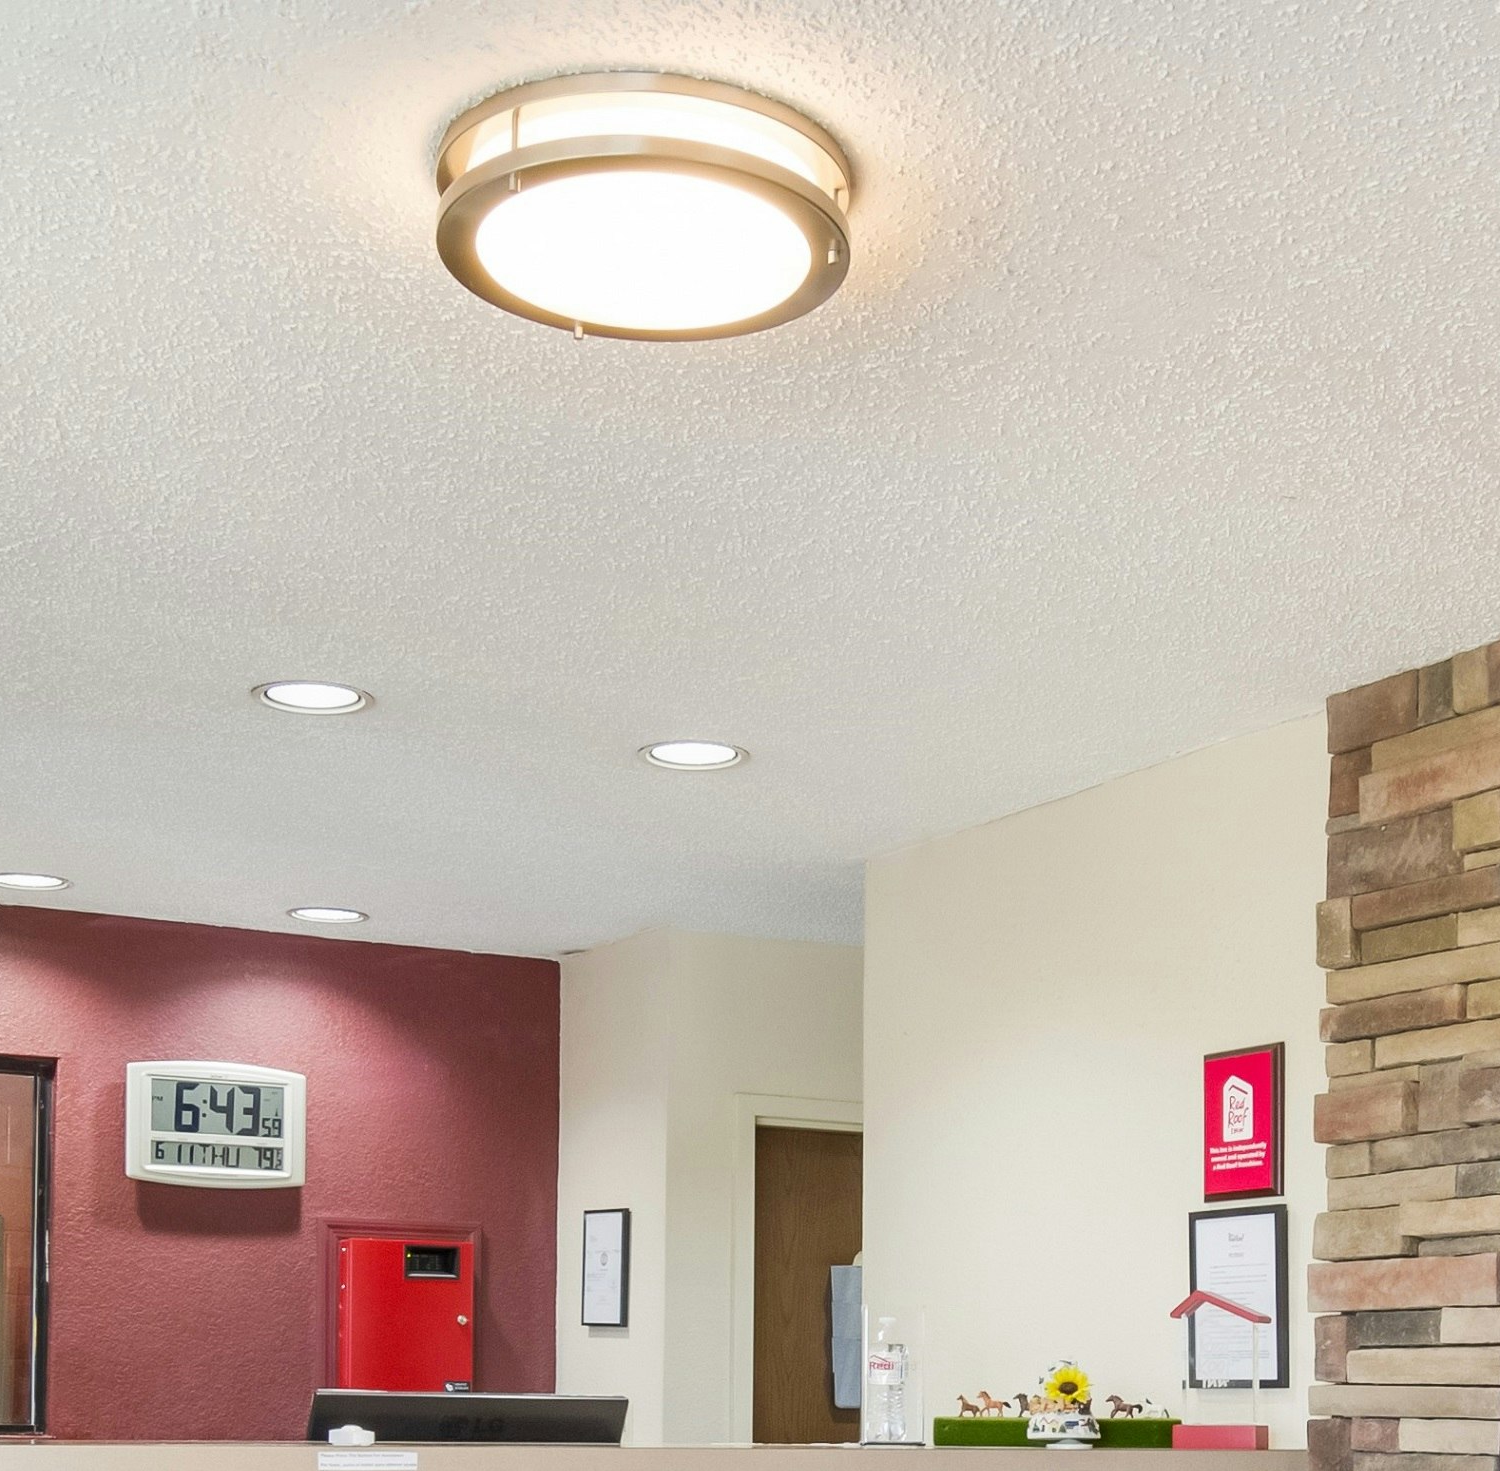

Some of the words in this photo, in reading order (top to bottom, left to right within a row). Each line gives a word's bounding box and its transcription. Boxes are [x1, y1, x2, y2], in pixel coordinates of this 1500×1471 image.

[175, 1081, 261, 1137] 6:43
[1229, 1095, 1246, 1110] Red
[1228, 1106, 1249, 1128] Roof
